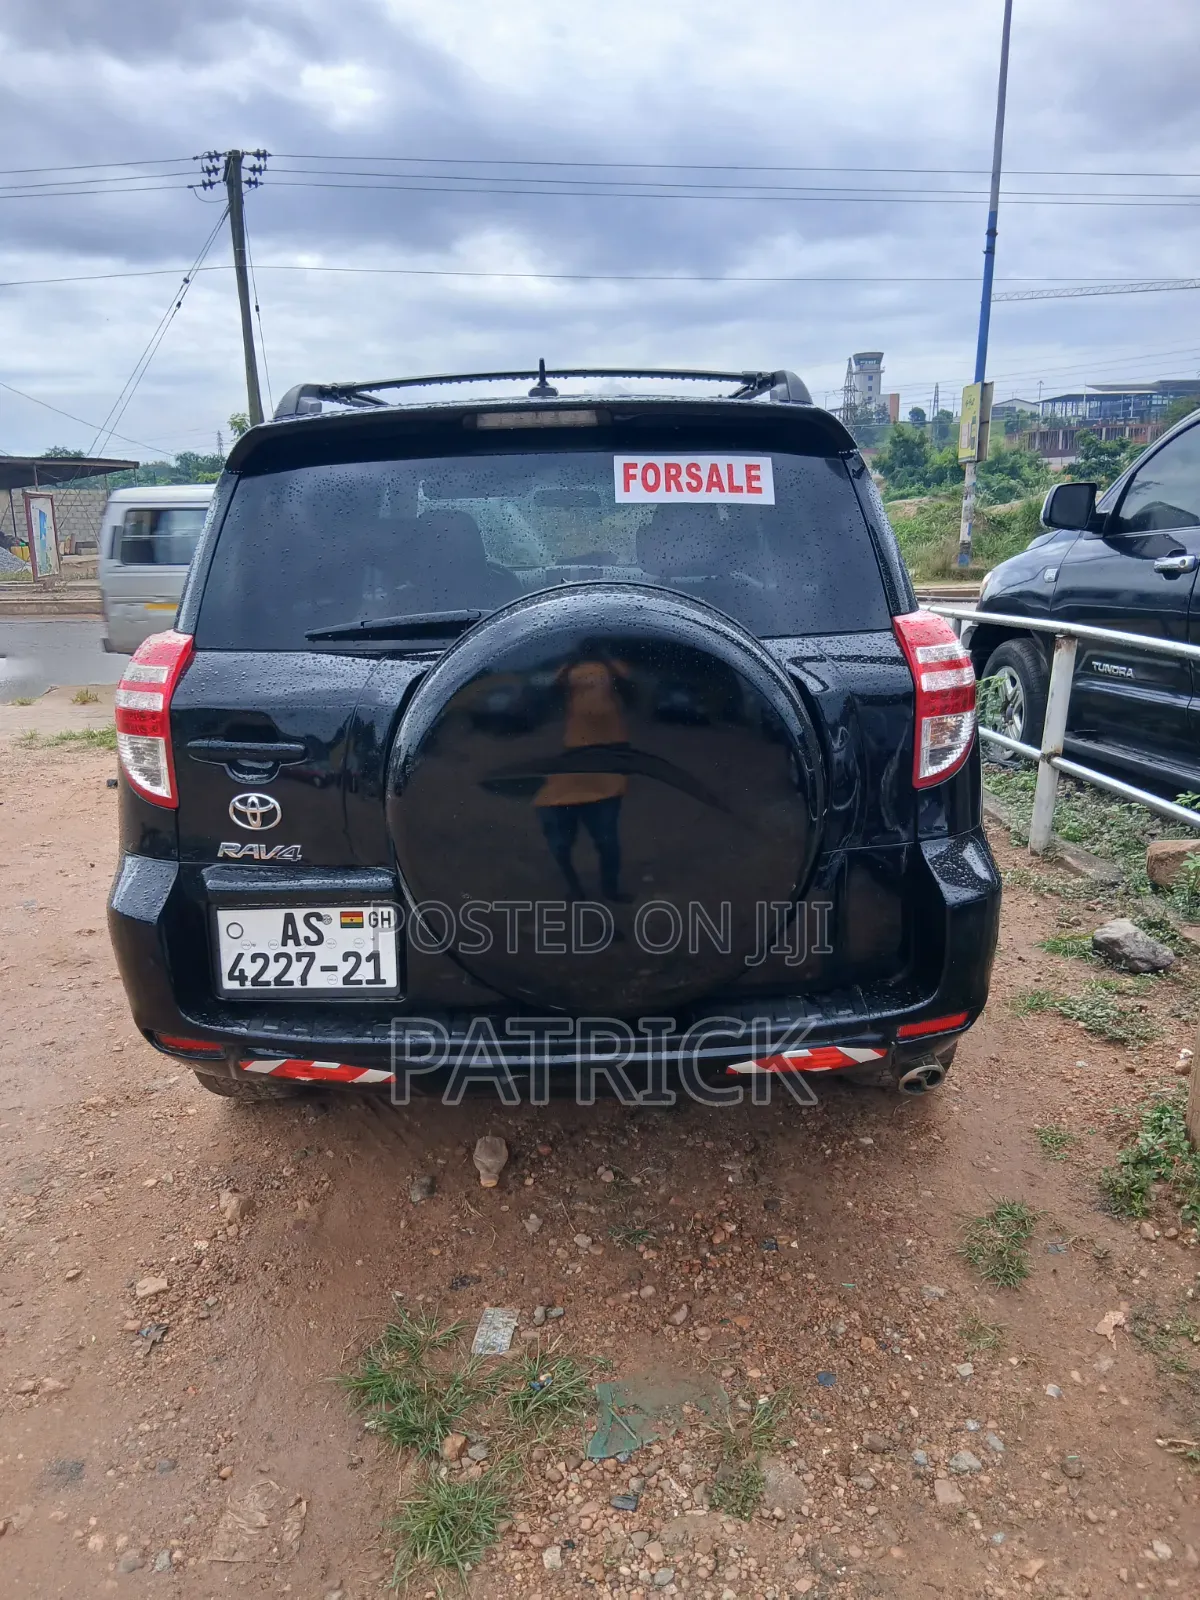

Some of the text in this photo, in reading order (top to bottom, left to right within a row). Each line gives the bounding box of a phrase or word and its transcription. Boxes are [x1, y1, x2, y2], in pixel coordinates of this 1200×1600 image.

[623, 462, 763, 494] FORSALE
[1091, 661, 1136, 679] TUNDRA
[217, 842, 303, 862] RAV4
[281, 911, 392, 947] AS GH
[227, 951, 387, 987] 4227-21
